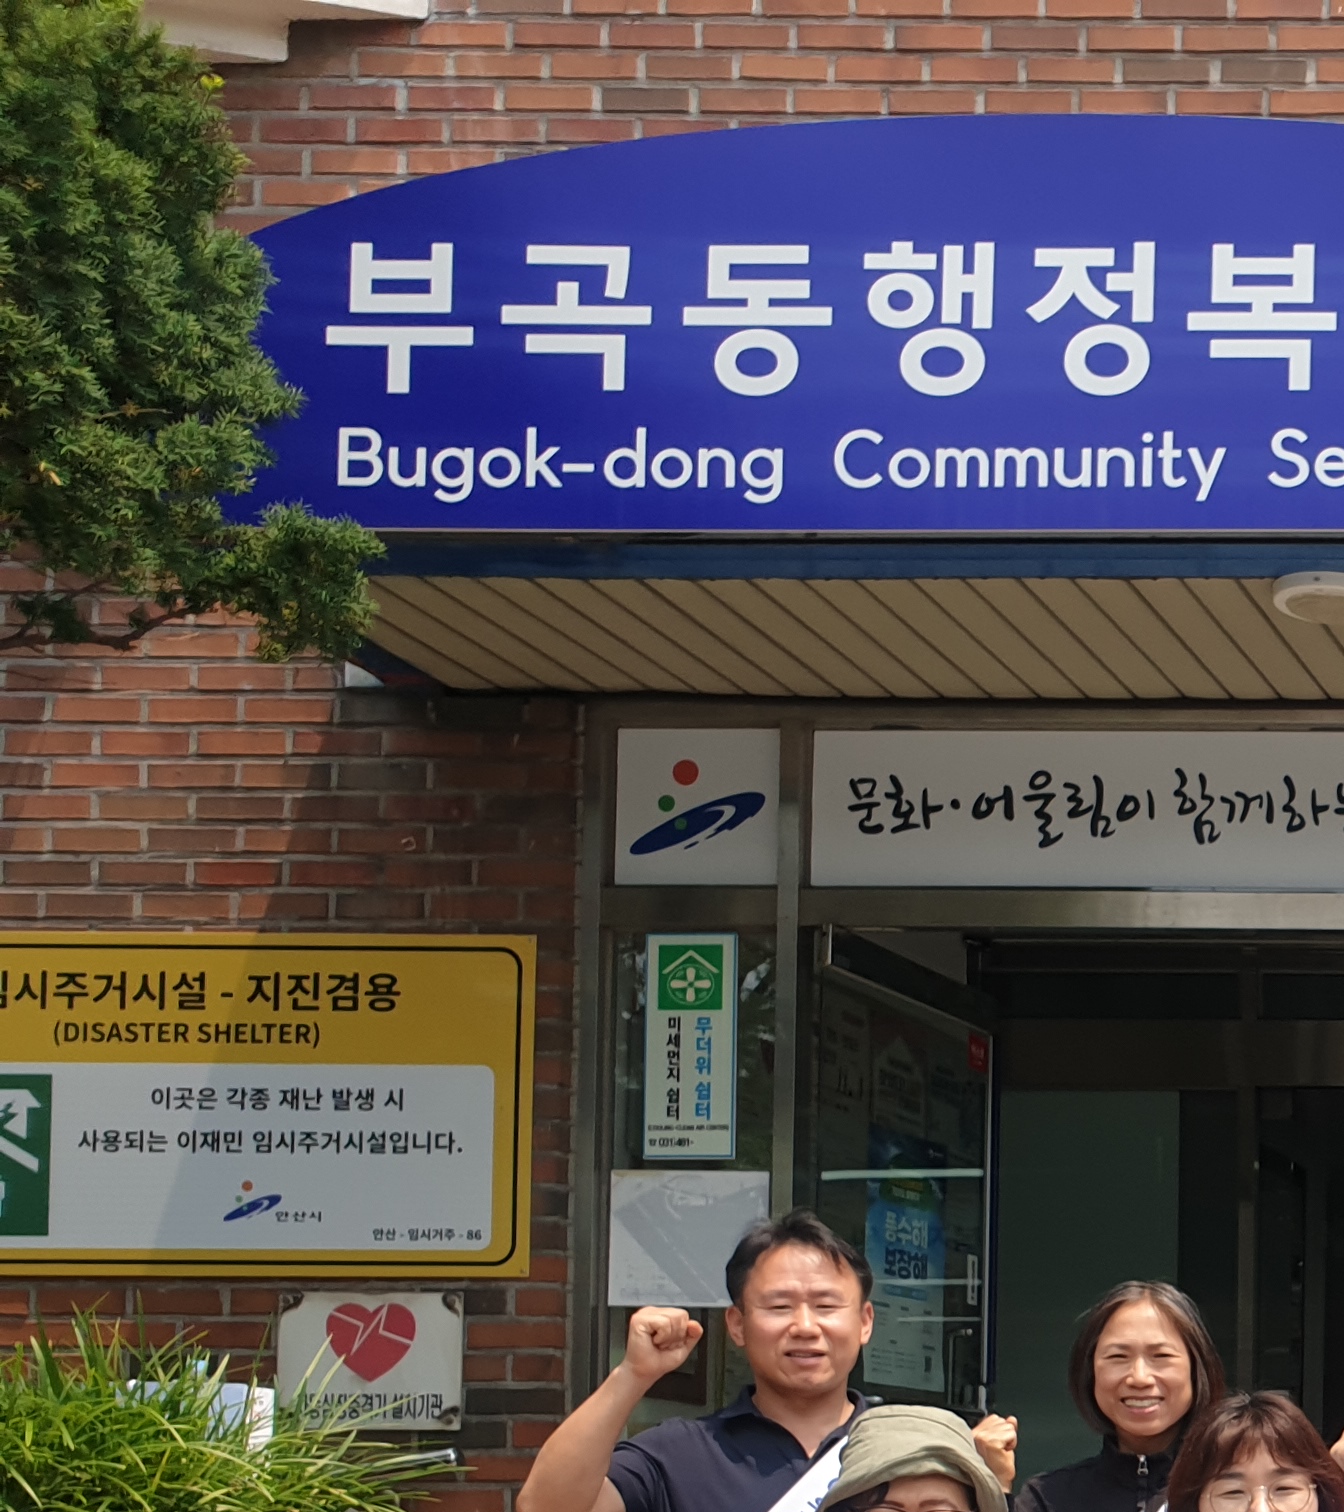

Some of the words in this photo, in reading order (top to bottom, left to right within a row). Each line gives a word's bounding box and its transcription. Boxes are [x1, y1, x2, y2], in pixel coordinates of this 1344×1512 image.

[336, 426, 785, 504] Bugok-dong
[832, 428, 1228, 502] Community
[246, 971, 402, 1012] 지진겸용
[53, 1020, 189, 1047] (DISASTER
[197, 1021, 321, 1049] SHELTER)
[666, 1016, 681, 1083] 미세먼지
[695, 1016, 712, 1076] 무더위
[151, 1086, 218, 1110] 이곳은
[226, 1087, 270, 1111] 각종
[279, 1087, 323, 1111] 재난
[332, 1087, 375, 1111] 발생
[384, 1088, 405, 1112] 시
[666, 1087, 680, 1121] 쉼터
[695, 1081, 712, 1121] 쉼터
[78, 1129, 168, 1153] 사용되는
[177, 1129, 243, 1154] 이재민
[252, 1130, 463, 1155] 임시주거시설입니다.
[275, 1210, 322, 1223] 안산시
[372, 1228, 396, 1241] 안산
[466, 1229, 482, 1241] 86
